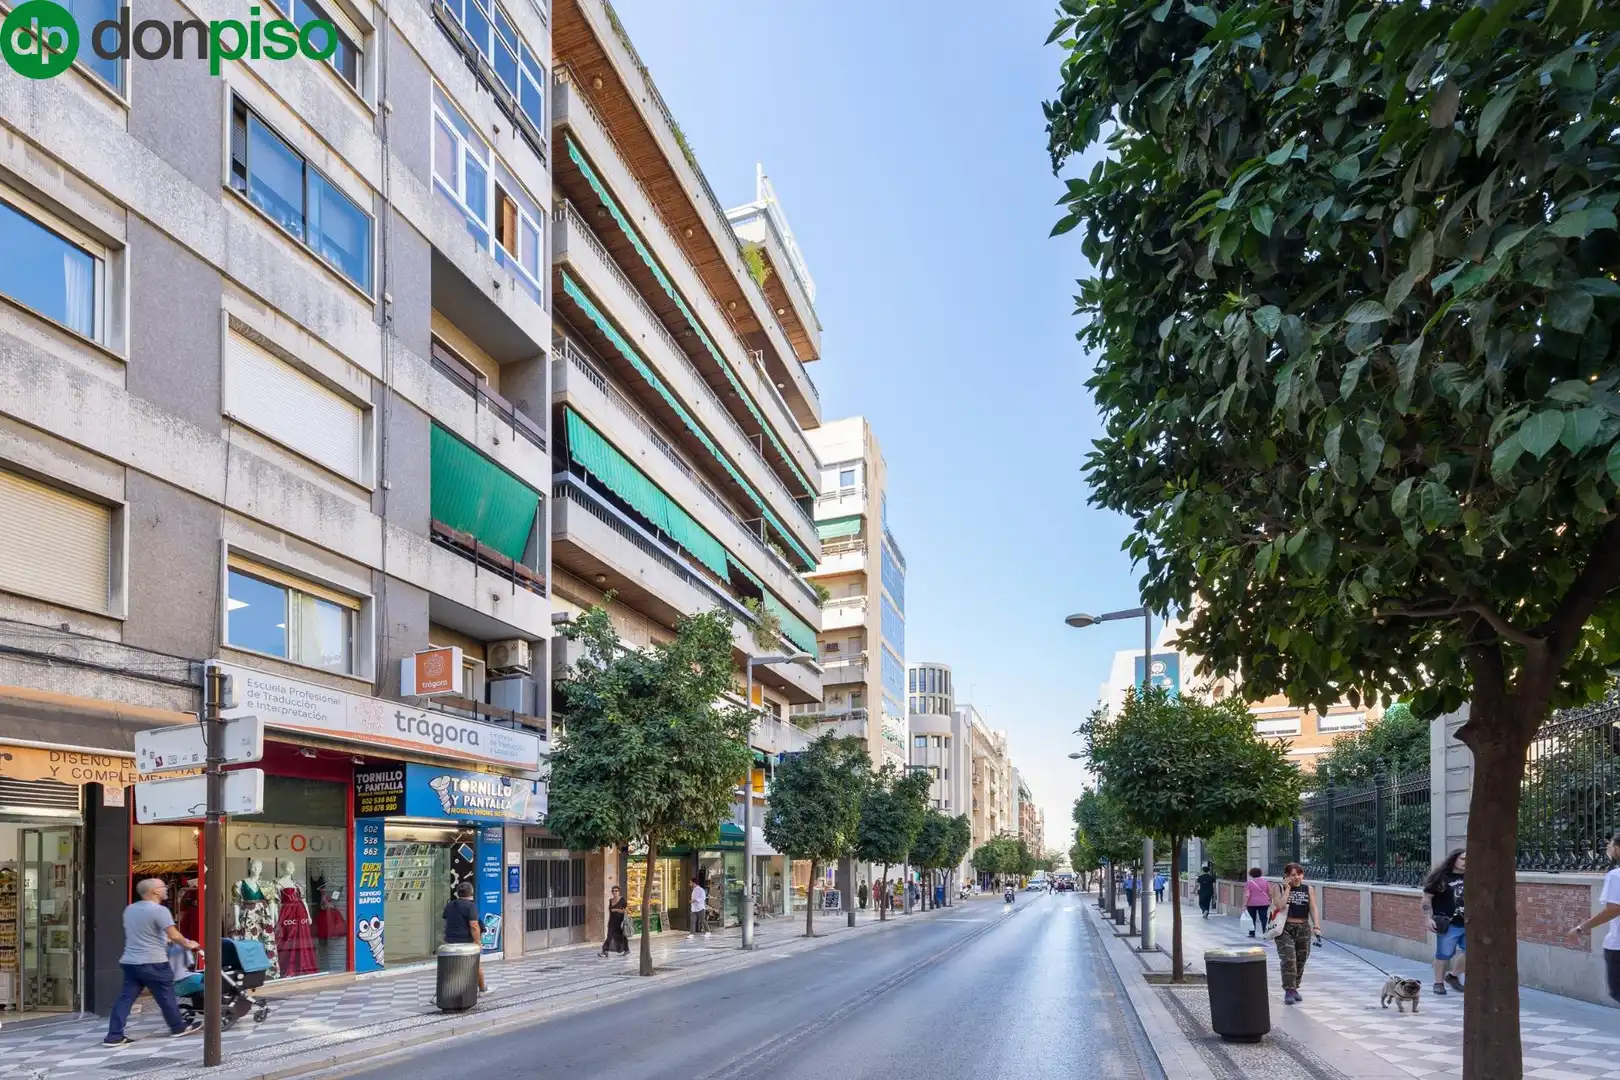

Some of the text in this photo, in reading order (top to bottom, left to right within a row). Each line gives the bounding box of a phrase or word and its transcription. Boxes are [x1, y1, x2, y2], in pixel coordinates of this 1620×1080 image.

[247, 678, 341, 706] Escuela Profesional
[422, 680, 448, 689] trágora
[247, 689, 317, 711] de Traducción
[256, 701, 328, 722] Interpretación
[394, 710, 480, 746] trágora
[50, 766, 60, 777] Y
[356, 771, 403, 784] TORNILLO
[356, 781, 404, 793] Y PANTALLA
[451, 777, 512, 797] TORNILLO
[451, 795, 513, 810] Y PANTALLA
[363, 825, 379, 833] 602
[363, 847, 378, 855] 863
[359, 871, 381, 888] FIX
